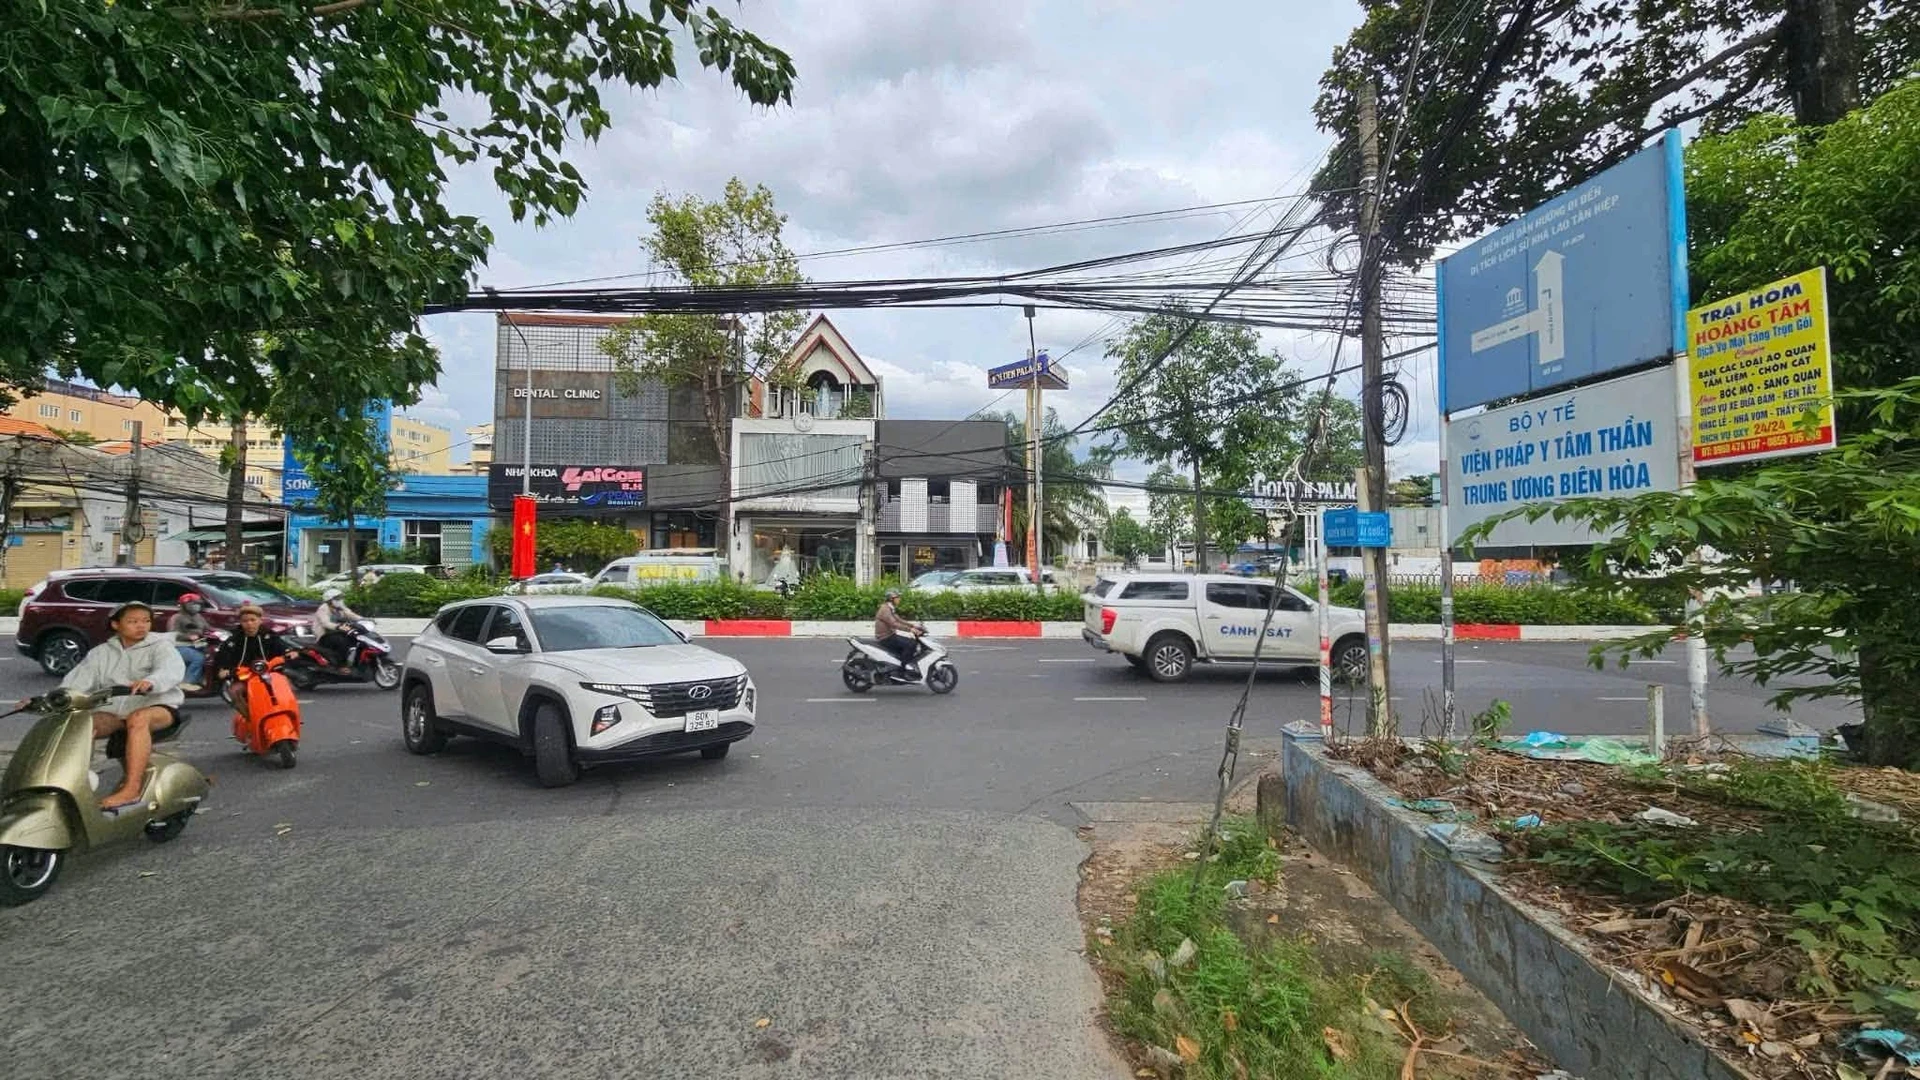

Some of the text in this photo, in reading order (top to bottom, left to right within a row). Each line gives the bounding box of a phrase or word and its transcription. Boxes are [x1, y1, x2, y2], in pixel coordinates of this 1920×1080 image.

[1767, 299, 1811, 324] TÂM
[1016, 361, 1043, 377] PALAE
[513, 388, 601, 399] DENTAL CLINIC
[1509, 397, 1576, 434] BỘ Y TẾ
[1754, 420, 1786, 435] 24/24
[1461, 415, 1652, 477] VIỆN PHÁP Y TÂM THẦN
[530, 468, 558, 477] KHOA
[1252, 470, 1358, 500] GOLDN PALAC
[1463, 458, 1651, 506] TRUNG ƯƠNG BIÊN HÒA
